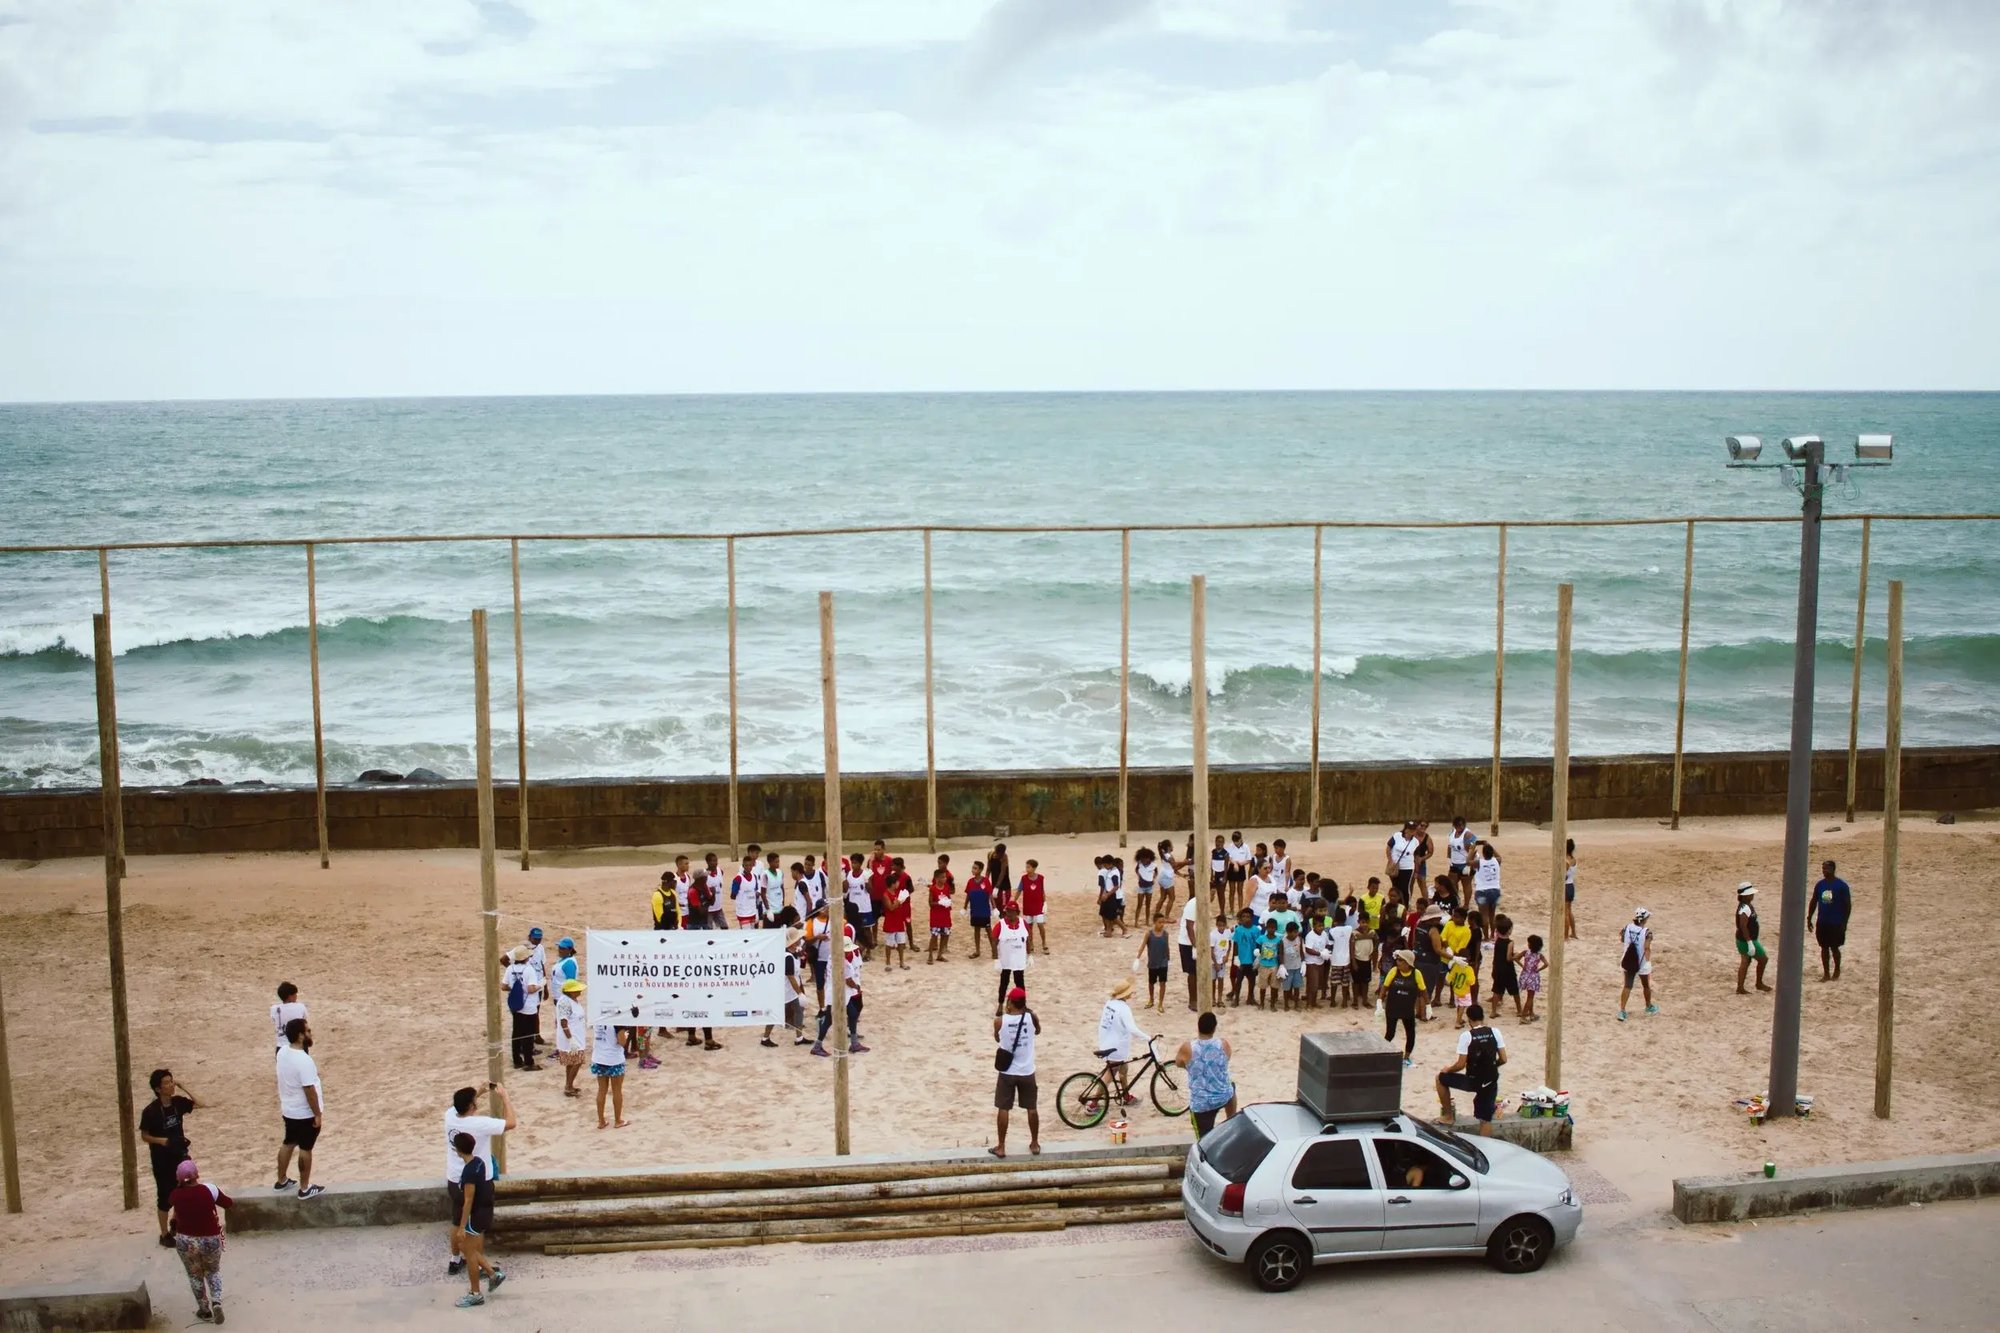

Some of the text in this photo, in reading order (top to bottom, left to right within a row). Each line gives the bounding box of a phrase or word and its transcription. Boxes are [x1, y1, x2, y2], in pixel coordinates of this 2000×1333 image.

[597, 960, 775, 979] MUTIRÃO DE CONSTRUÇÃO
[1453, 972, 1467, 990] 10
